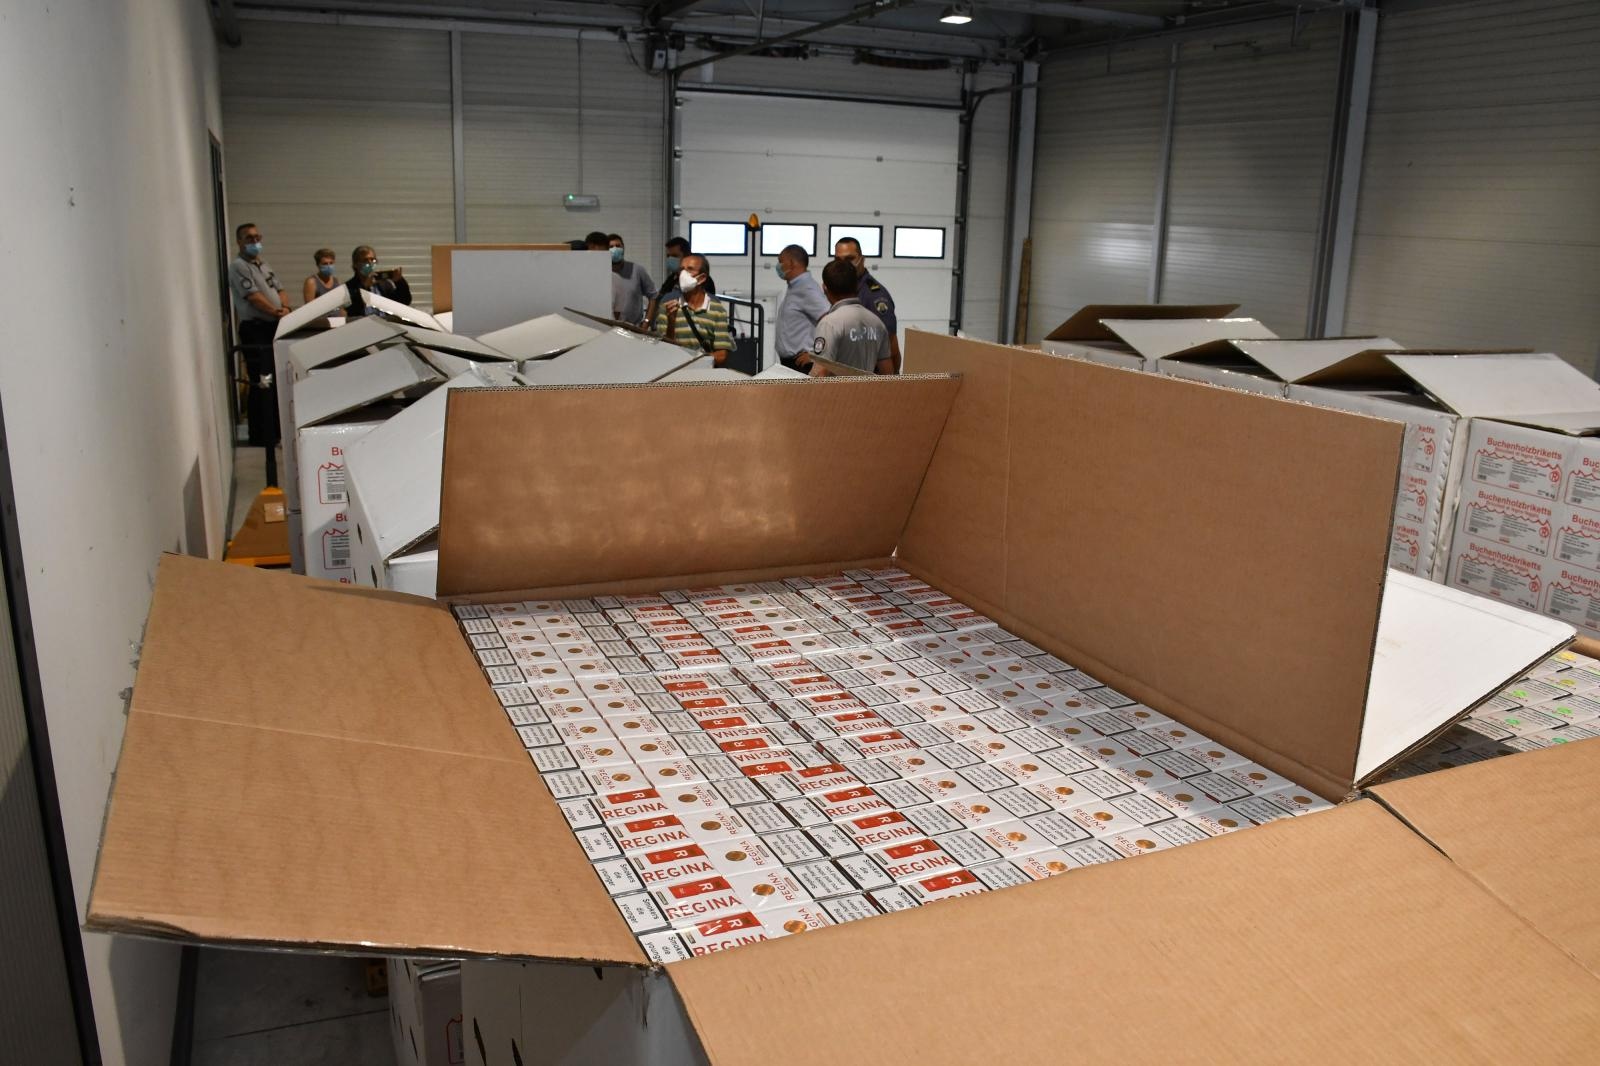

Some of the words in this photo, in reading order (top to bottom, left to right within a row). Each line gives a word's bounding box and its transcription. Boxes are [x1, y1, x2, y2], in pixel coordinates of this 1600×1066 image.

[1487, 437, 1562, 461] Buchenholzbriketts
[1478, 490, 1552, 516] Buchenholzbriketts
[1572, 514, 1600, 529] Buche
[1469, 542, 1542, 572] Buchenholzbriketts
[1562, 570, 1600, 590] Buchenh
[660, 641, 708, 650] REGINA
[751, 648, 797, 658] REGINA
[676, 657, 726, 666] REGINA
[789, 684, 838, 694] REGINA
[695, 706, 748, 717] REGINA
[810, 702, 860, 713] REGINA
[713, 727, 769, 738] REGINA
[834, 721, 884, 733] REGINA
[734, 749, 792, 762] REGINA
[860, 742, 911, 756] REGINA
[798, 776, 857, 792] REGINA
[602, 803, 668, 820] REGINA
[825, 800, 887, 817] REGINA
[1200, 816, 1228, 833] REGIN
[620, 830, 690, 850] REGINA
[854, 827, 920, 846] REGINA
[987, 827, 1019, 852] REGINA
[1115, 836, 1144, 855] REGIN
[740, 840, 766, 867] REGINA
[641, 861, 714, 883] REGINA
[887, 855, 954, 878] REGINA
[1027, 857, 1053, 878] REGIN
[768, 872, 794, 902] REGINA
[665, 895, 743, 920] REGINA
[668, 936, 687, 960] Smokers
